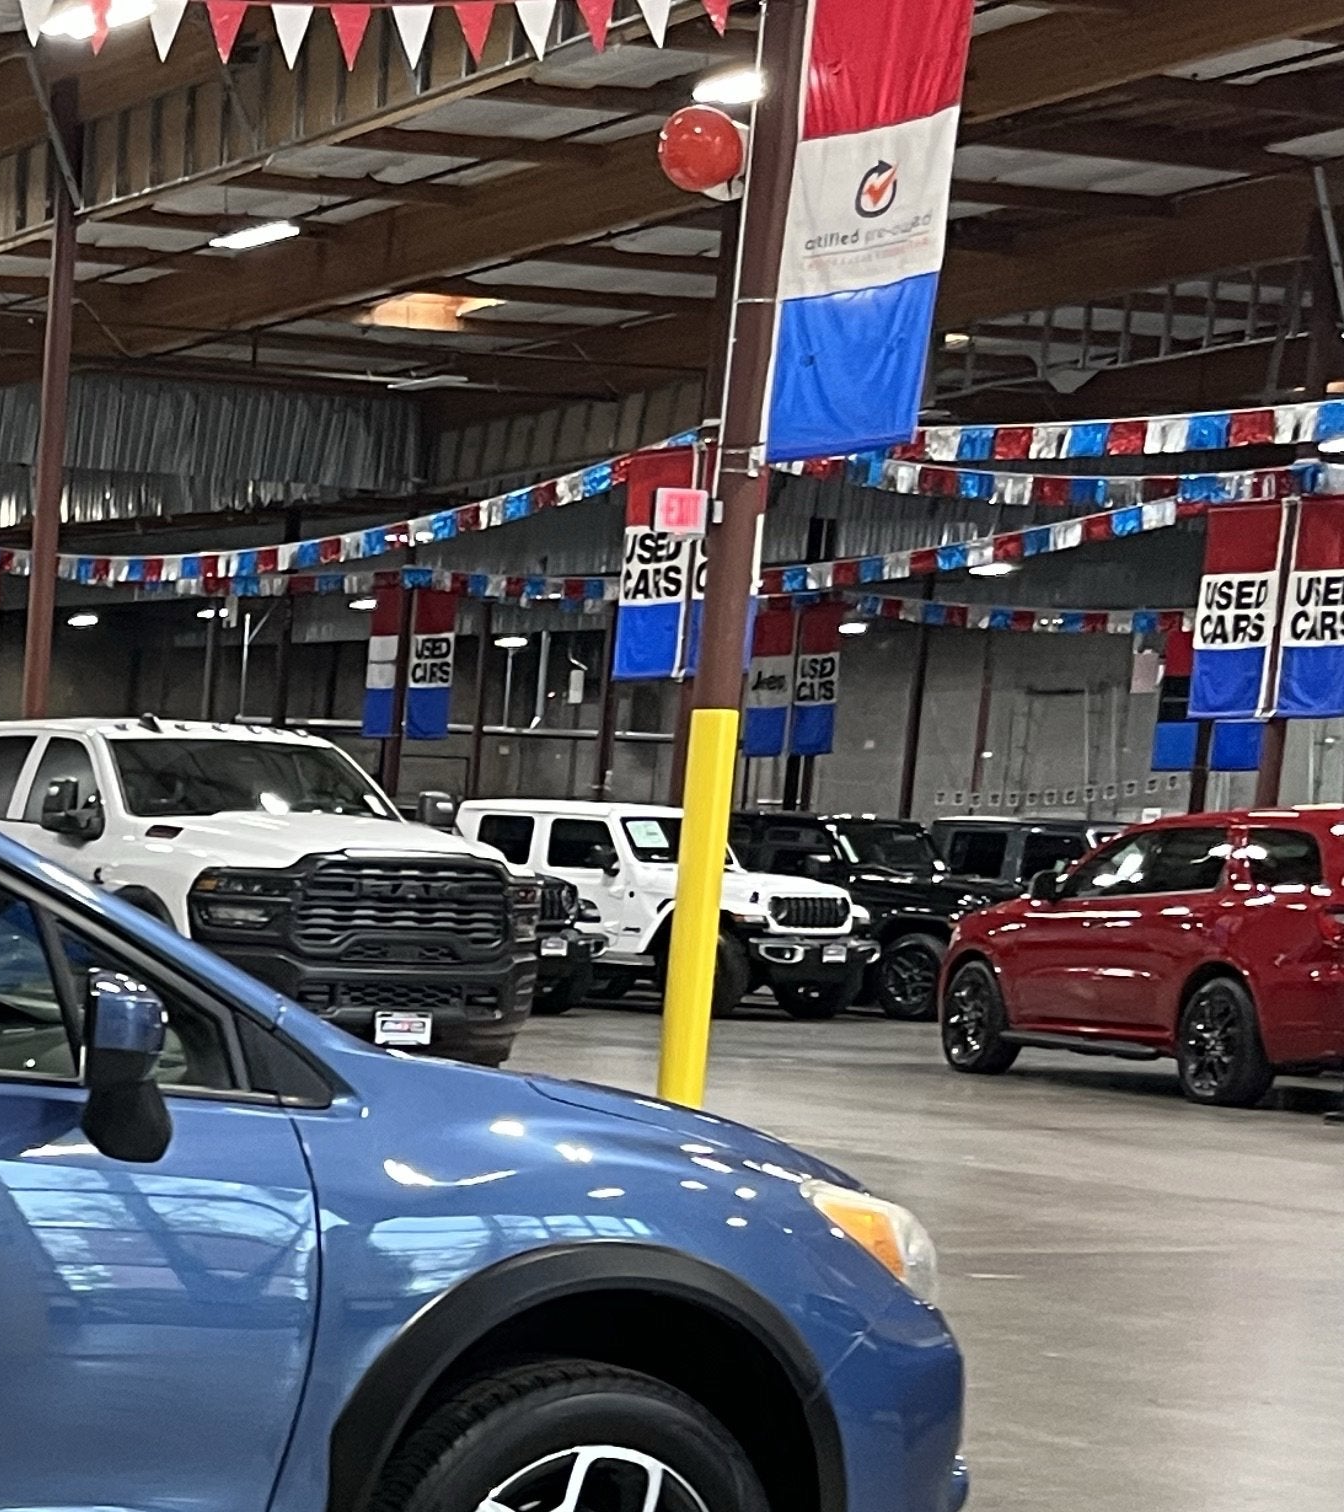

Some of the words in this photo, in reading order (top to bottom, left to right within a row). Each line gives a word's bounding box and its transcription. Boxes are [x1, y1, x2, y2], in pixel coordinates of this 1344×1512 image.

[805, 228, 860, 250] ctified
[1205, 579, 1269, 610] USED
[1296, 576, 1344, 607] USE
[1200, 612, 1265, 644] CARS
[1291, 610, 1344, 641] CAR
